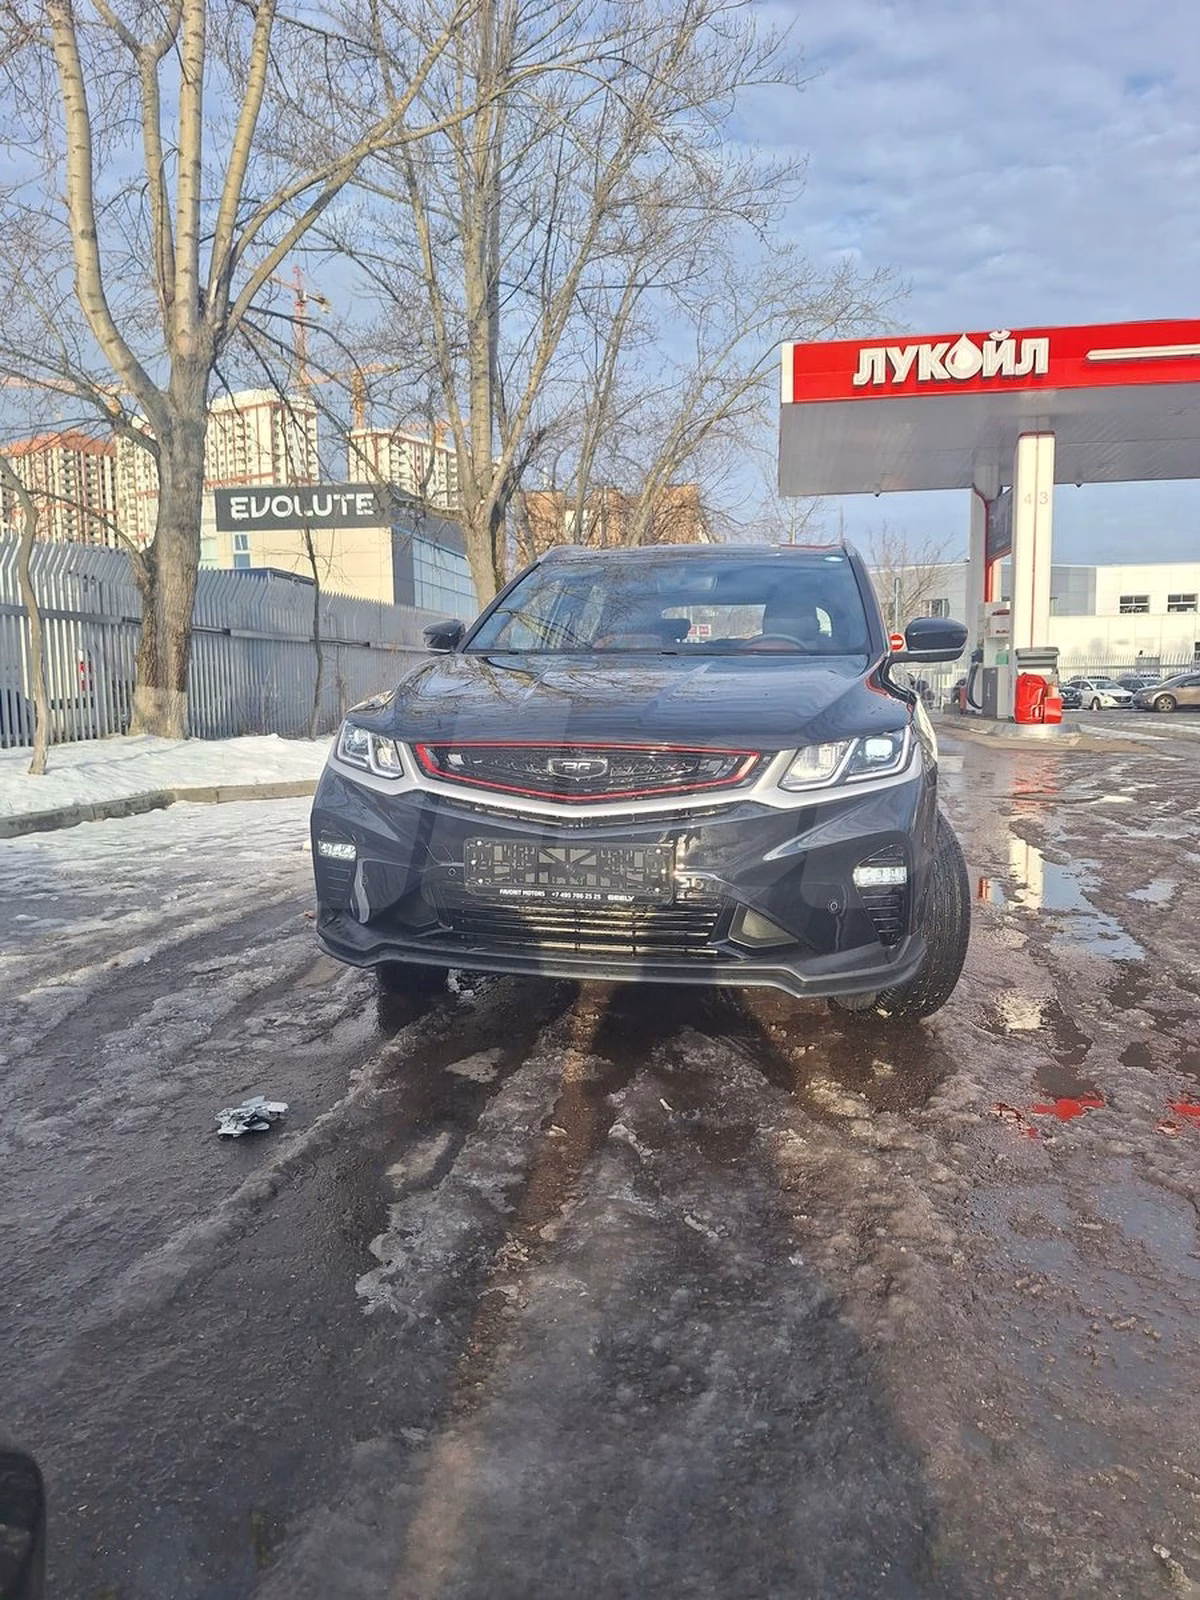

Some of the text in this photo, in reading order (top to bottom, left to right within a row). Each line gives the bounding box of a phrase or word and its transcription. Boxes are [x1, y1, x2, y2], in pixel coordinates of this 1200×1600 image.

[852, 329, 1050, 386] ЛУКОЙЛ
[1024, 492, 1032, 505] 4
[1039, 491, 1049, 505] 3
[230, 493, 374, 520] EVOLUTE
[607, 894, 635, 902] GEELY
